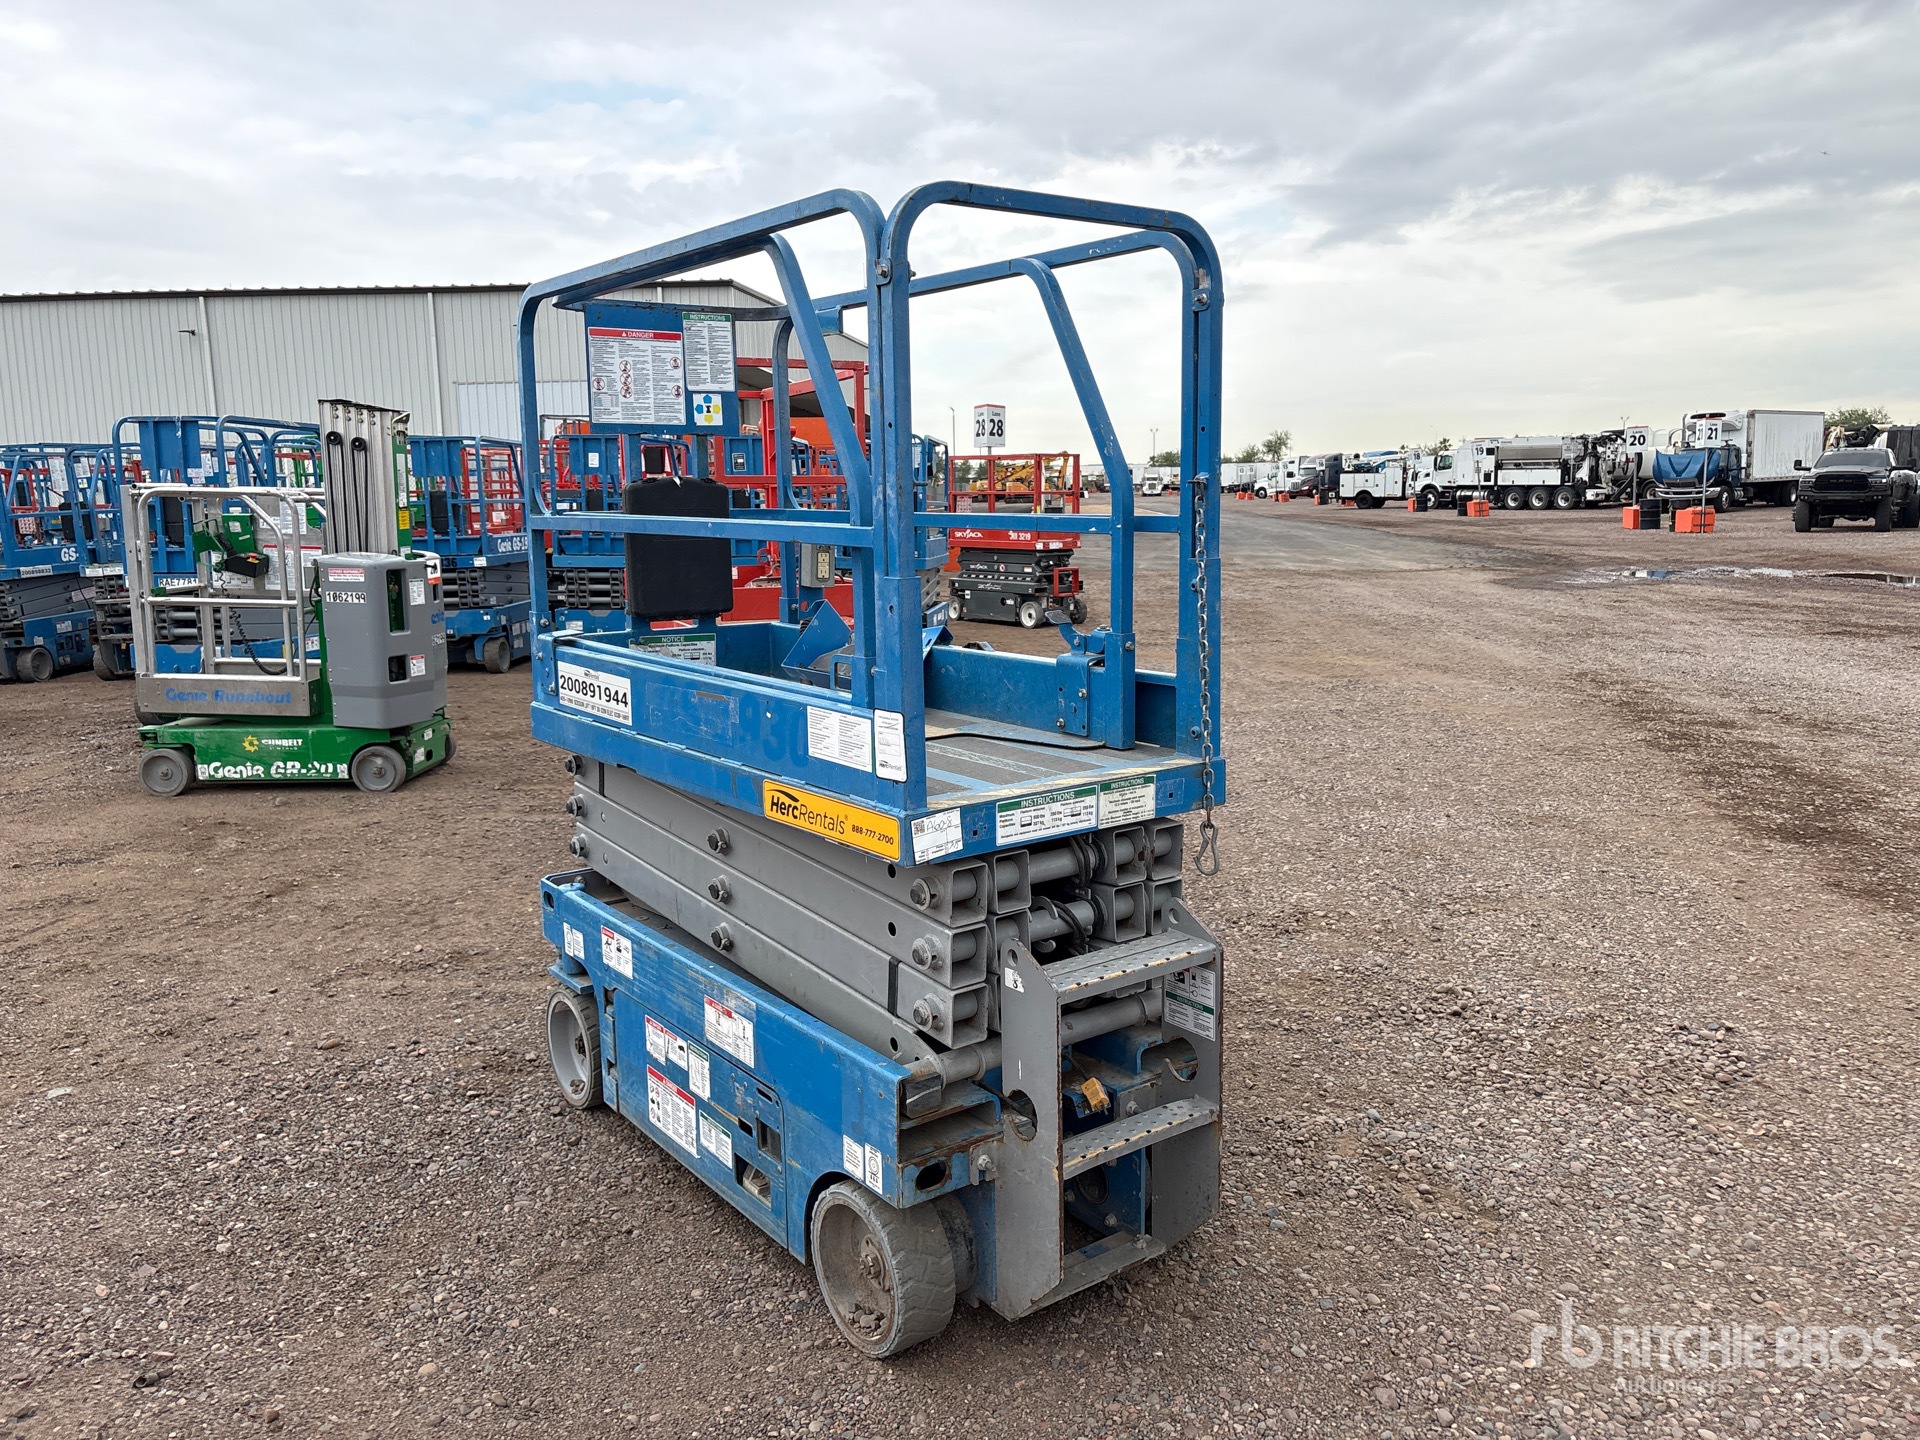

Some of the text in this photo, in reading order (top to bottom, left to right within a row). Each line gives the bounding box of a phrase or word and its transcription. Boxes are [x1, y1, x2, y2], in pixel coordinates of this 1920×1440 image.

[689, 314, 726, 322] INSTRUCTIONS
[628, 331, 654, 339] DANGER
[976, 419, 986, 437] 28
[989, 419, 1003, 437] 28
[1707, 427, 1718, 440] 21
[1629, 434, 1646, 446] 20
[1413, 452, 1420, 460] 18
[1475, 447, 1484, 455] 19
[955, 529, 983, 538] SKYJACK
[327, 592, 366, 603] 1062199
[165, 688, 292, 704] Genie Runabout
[560, 675, 628, 708] 200891944
[209, 761, 264, 779] Genie
[1111, 778, 1145, 790] INSTRUCTIONS
[1020, 791, 1075, 808] INSTRUCTIONS
[851, 824, 894, 845] 888-777-2700
[1176, 996, 1204, 1010] INSTRUCTIONS
